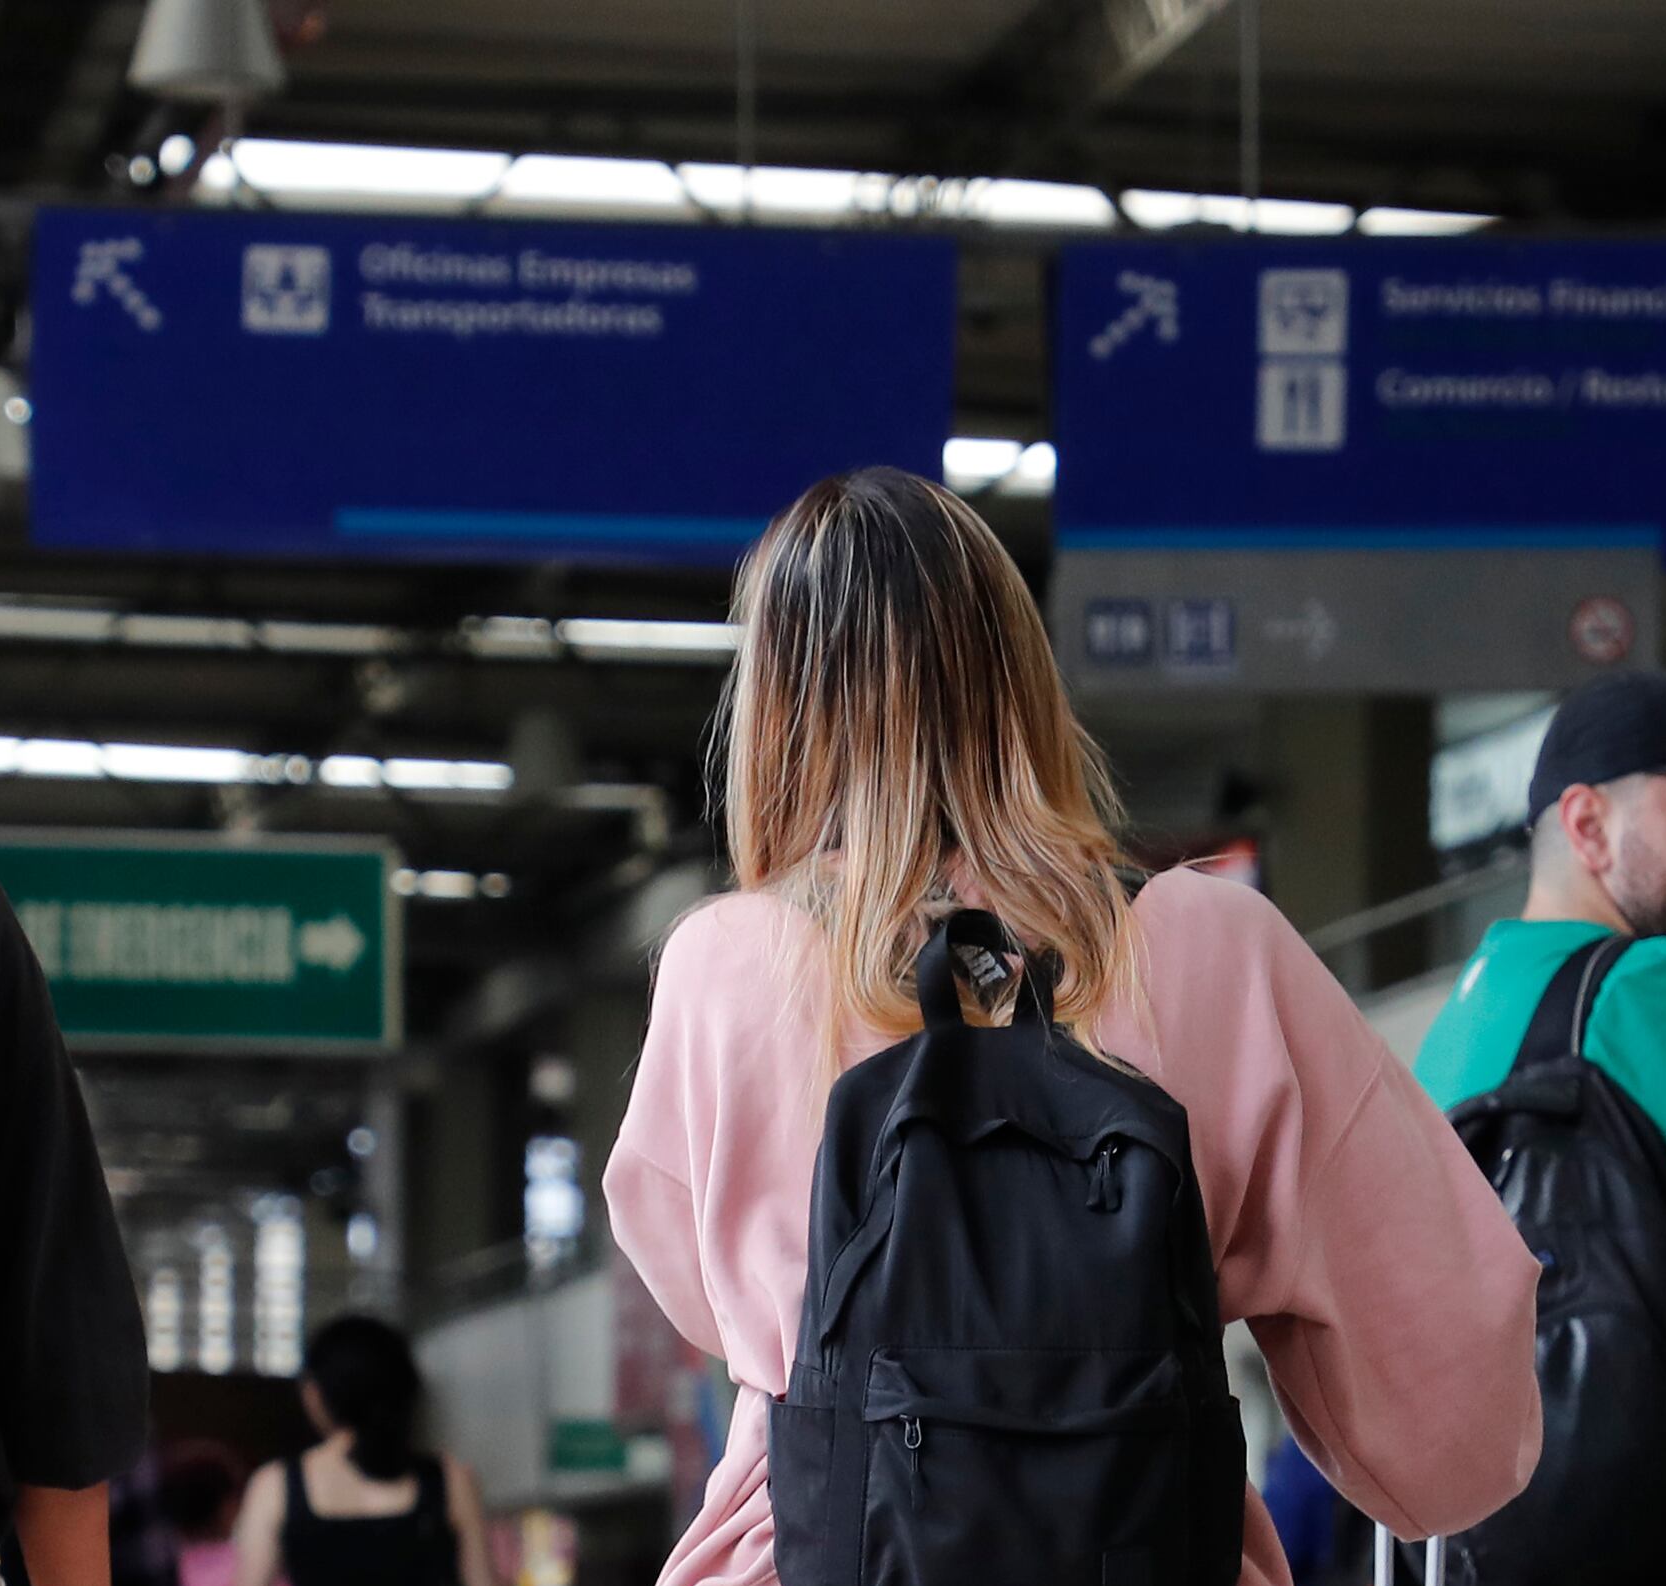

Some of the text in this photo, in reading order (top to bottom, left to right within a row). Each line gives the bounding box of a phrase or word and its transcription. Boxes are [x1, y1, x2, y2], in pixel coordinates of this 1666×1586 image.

[359, 243, 696, 293] Oficinas Empresas
[363, 292, 662, 337] Transportadoras
[1380, 276, 1541, 316] Servicios
[1376, 367, 1553, 406] Comercio
